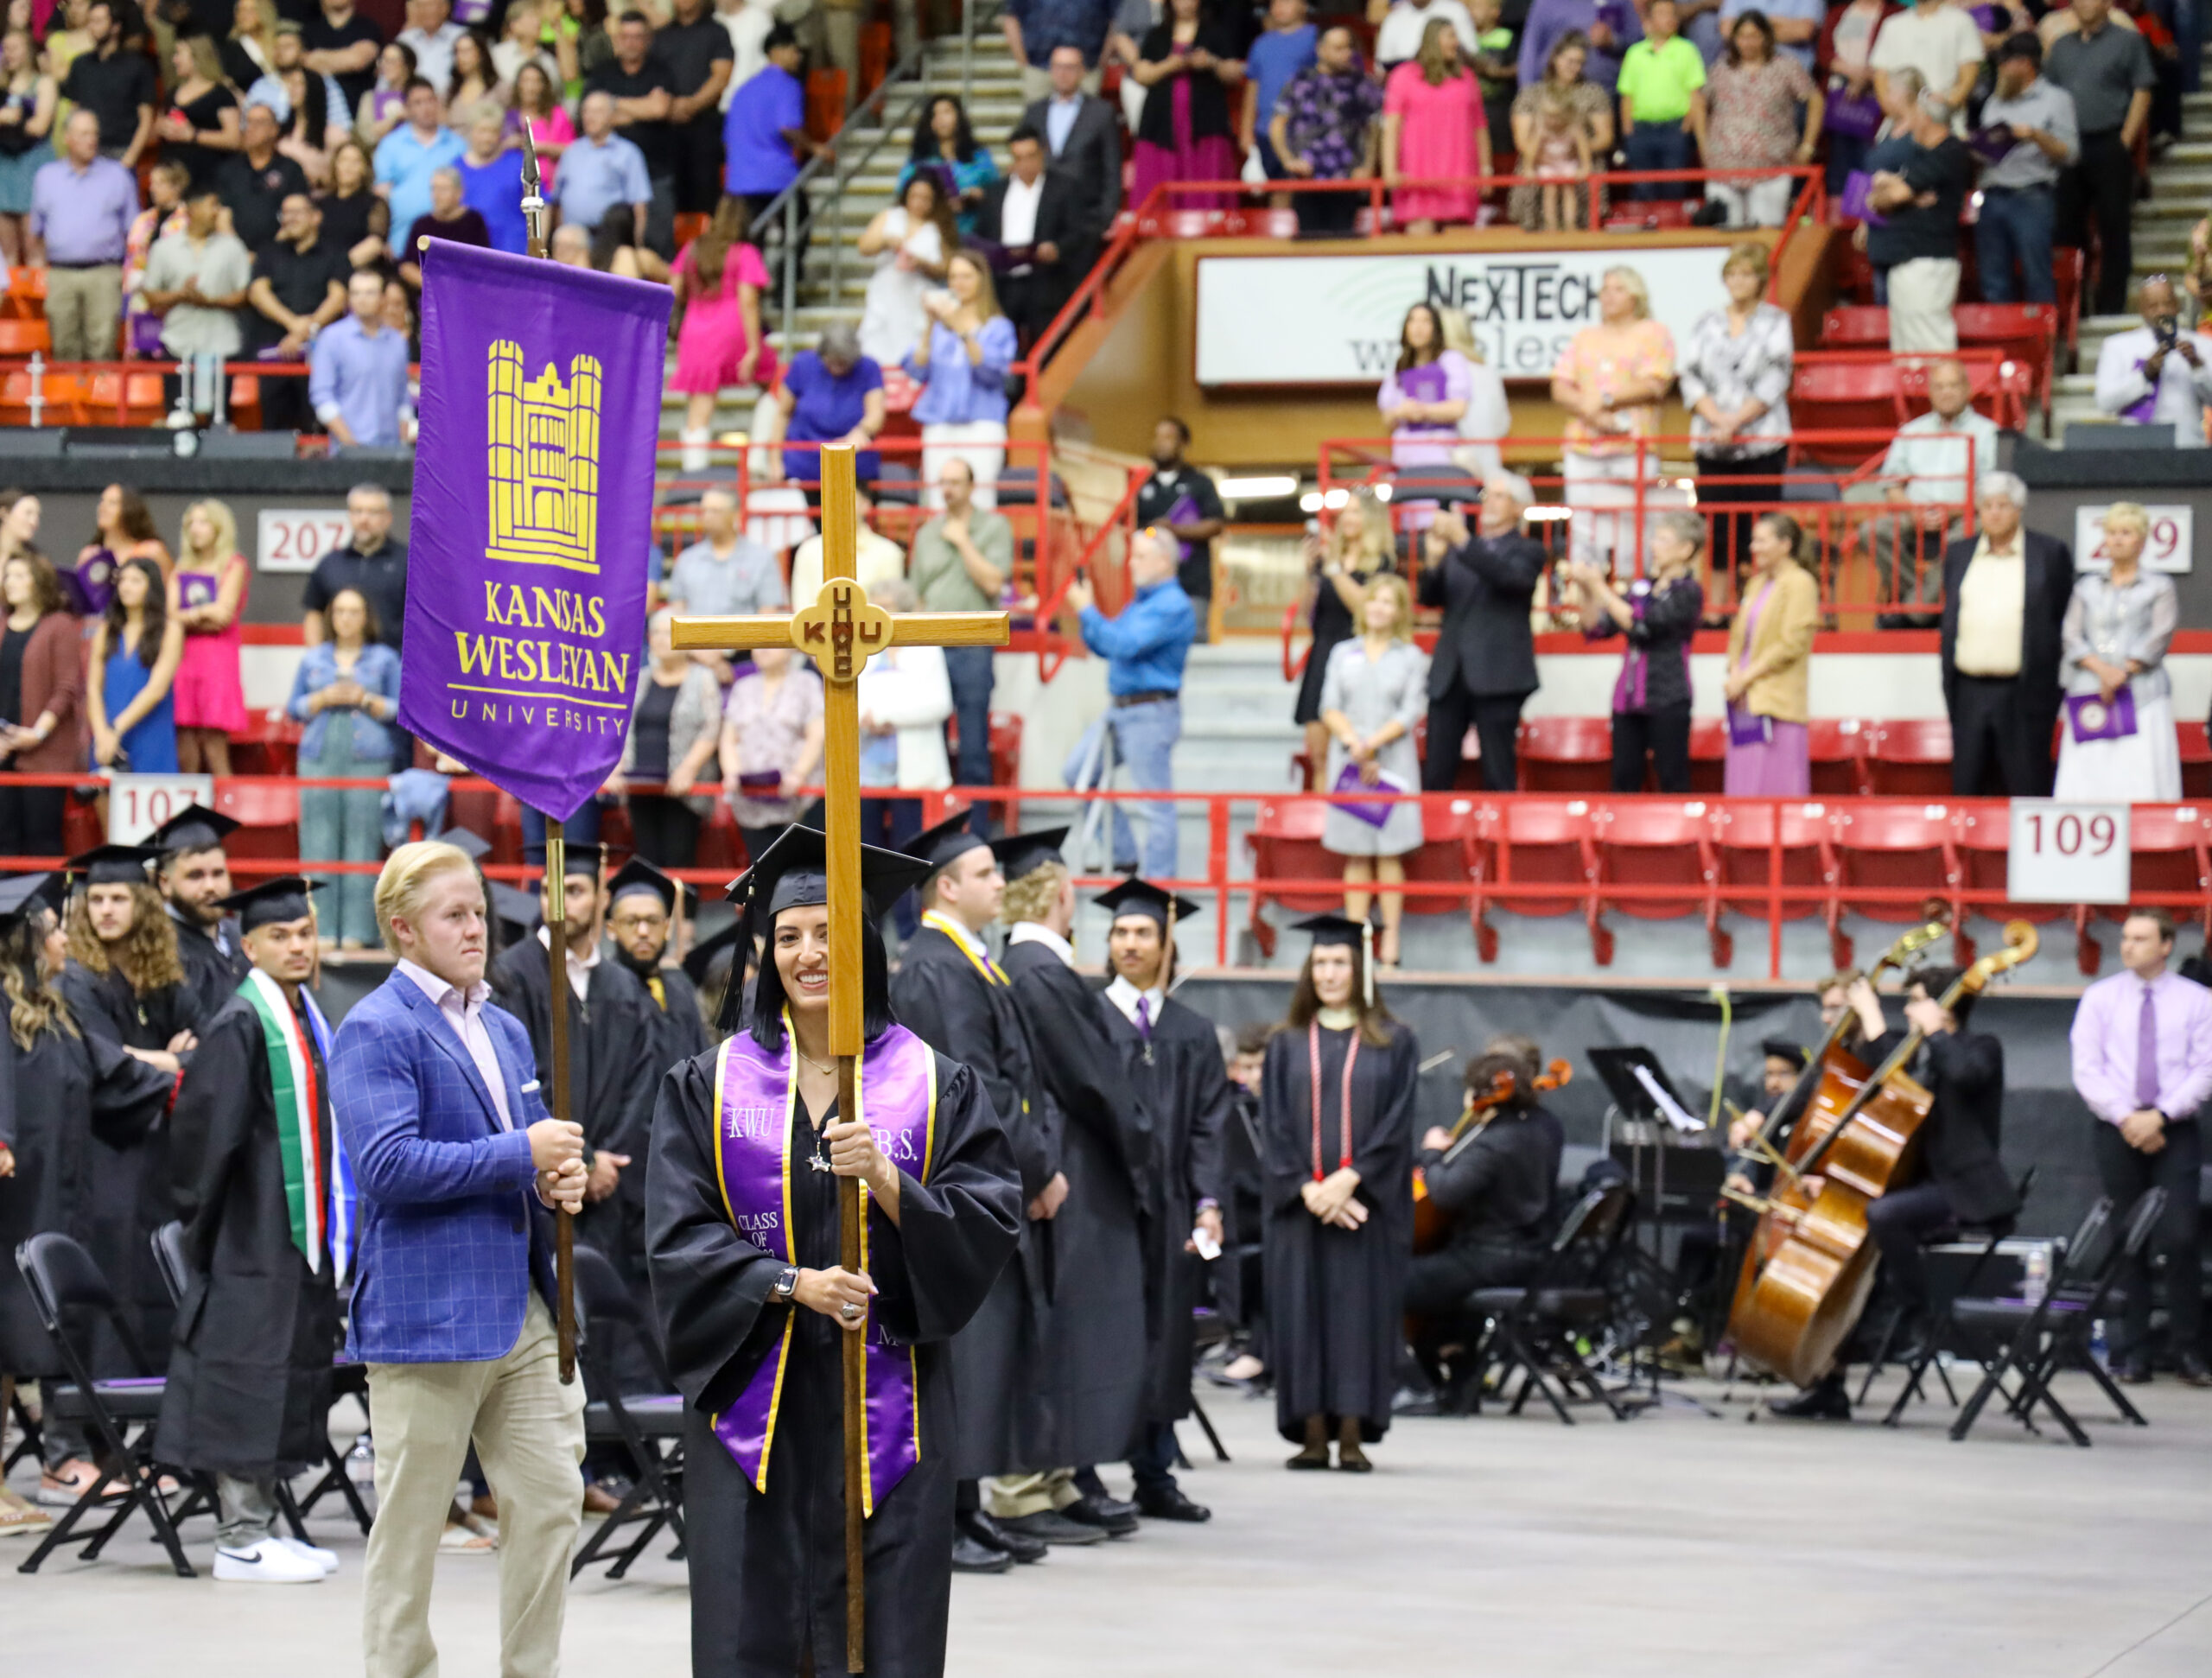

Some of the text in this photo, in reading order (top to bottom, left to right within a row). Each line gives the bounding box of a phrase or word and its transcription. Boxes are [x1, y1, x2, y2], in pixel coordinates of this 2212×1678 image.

[271, 521, 344, 560] 207
[484, 580, 606, 638] KANSAS
[454, 631, 631, 694] WESLEYAN
[451, 698, 624, 737] UNIVERSITY
[2026, 814, 2115, 856] 109
[728, 1108, 775, 1139] KWU
[874, 1128, 918, 1161] B.S.
[738, 1211, 779, 1231] CLASS
[751, 1230, 768, 1248] OF
